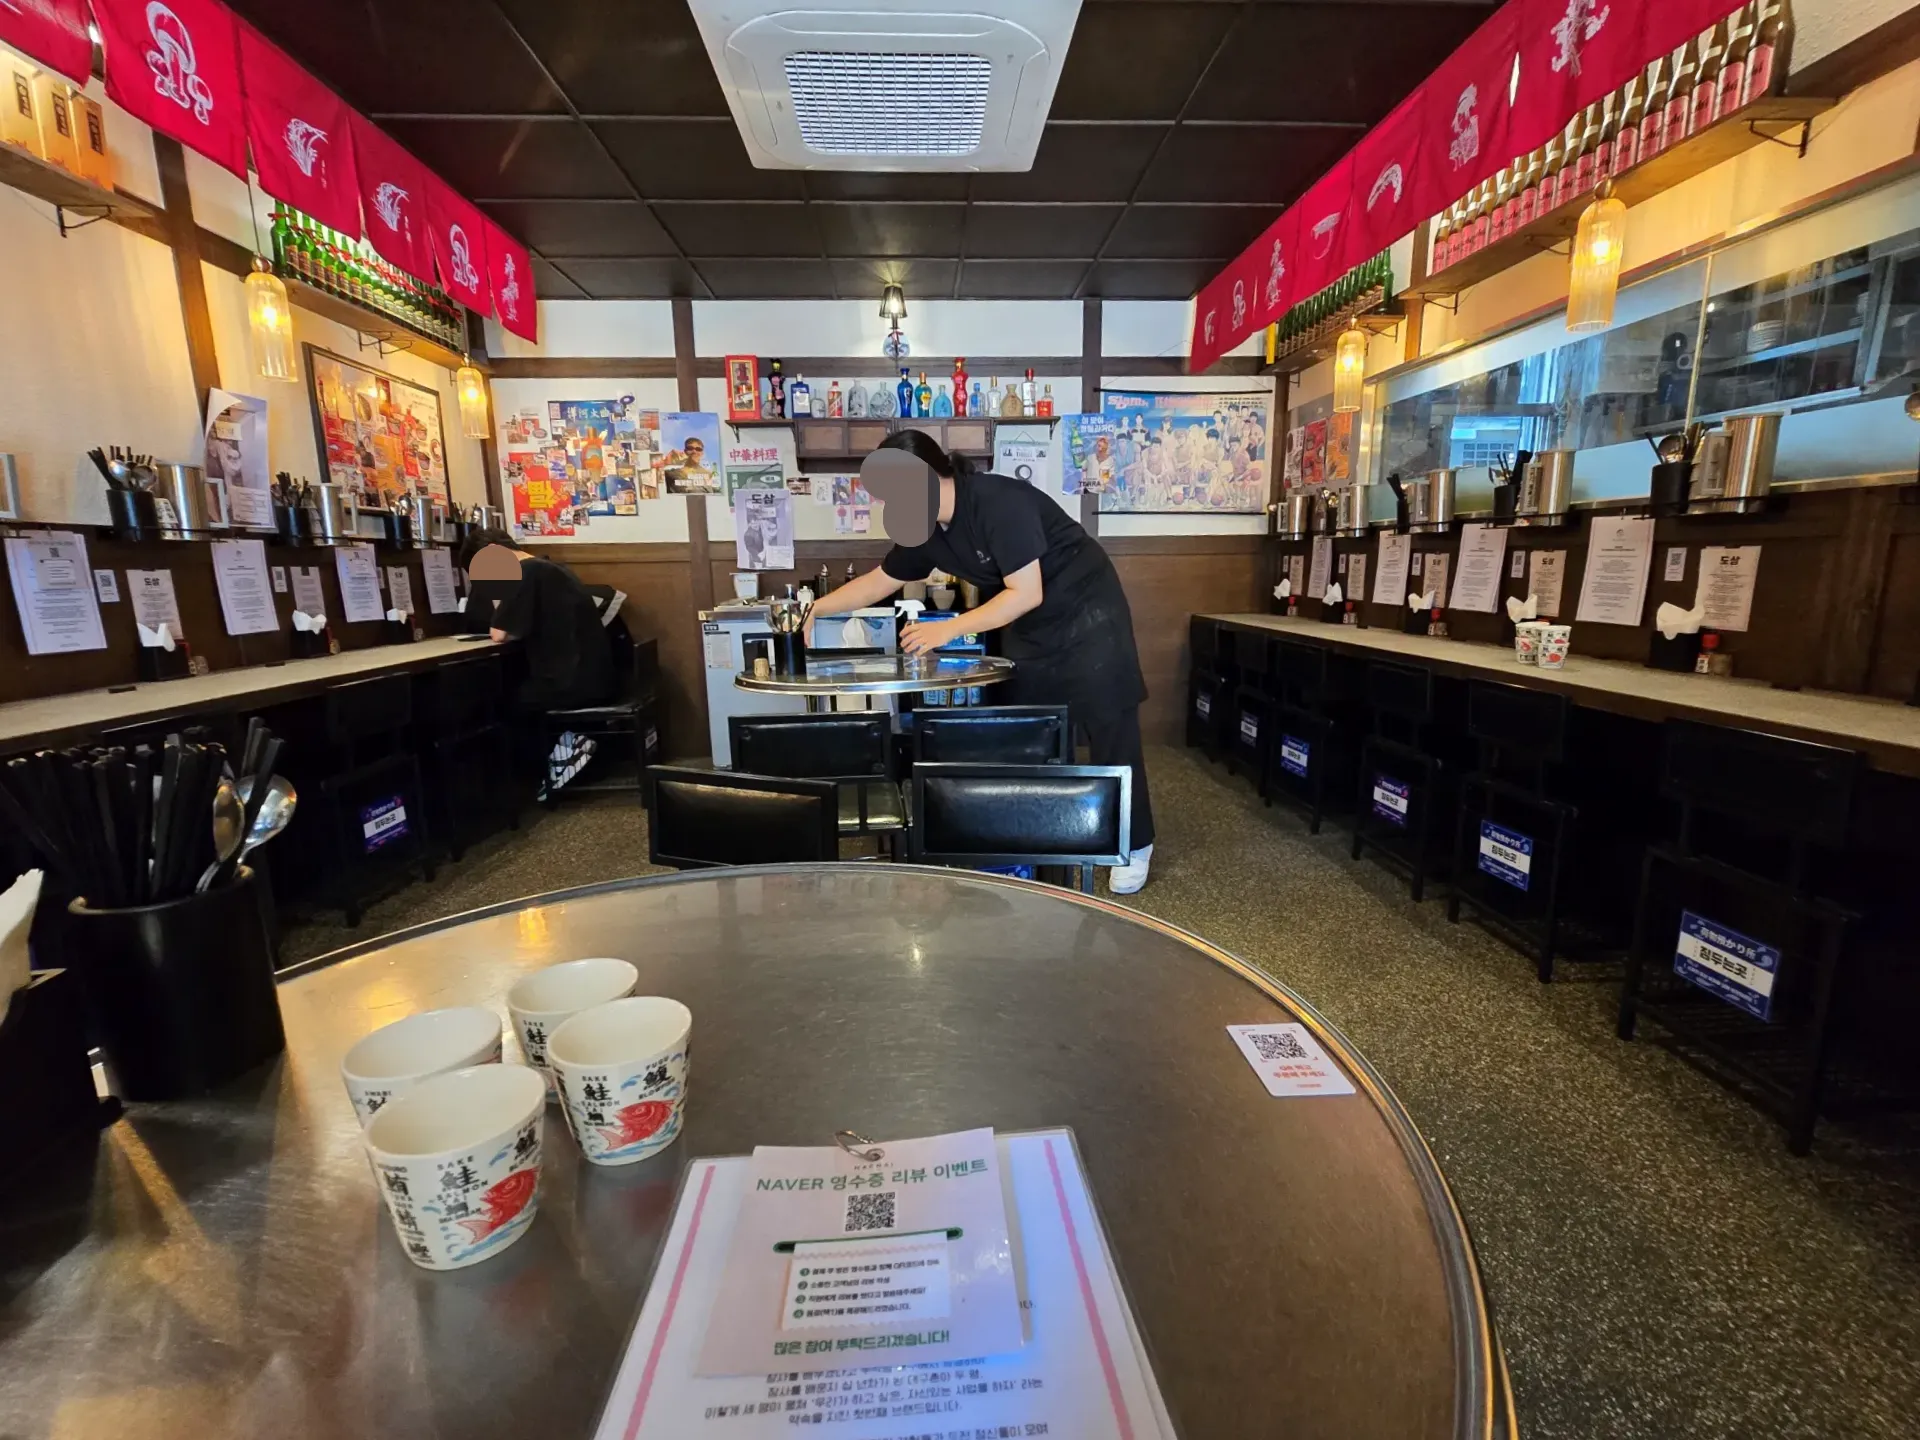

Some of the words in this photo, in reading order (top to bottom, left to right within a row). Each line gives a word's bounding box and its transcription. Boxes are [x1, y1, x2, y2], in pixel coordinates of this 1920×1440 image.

[730, 448, 779, 463] 中華料理
[752, 494, 775, 505] 도삼
[1720, 555, 1742, 566] 도삼
[1699, 945, 1749, 980] 짐두는곳
[583, 1082, 613, 1101] 鮭
[580, 1100, 620, 1108] SALMON
[437, 1154, 474, 1171] SAKE
[440, 1165, 480, 1190] 鮭
[756, 1177, 825, 1191] NAVER
[830, 1172, 885, 1190] 영수증
[891, 1167, 928, 1185] 리뷰
[933, 1158, 989, 1180] 이벤트
[437, 1179, 489, 1202] SALMON
[774, 1340, 803, 1357] 많은
[805, 1339, 834, 1355] 참여
[835, 1329, 951, 1352] 부탁드리겠습니다!
[705, 1404, 740, 1420] 이렇게
[758, 1401, 781, 1414] 명이
[852, 1393, 875, 1406] 하고
[908, 1386, 951, 1400] 자신있는
[1021, 1378, 1043, 1390] 라는
[853, 1407, 888, 1420] 첫번째
[892, 1400, 963, 1417] 브랜드입니다.
